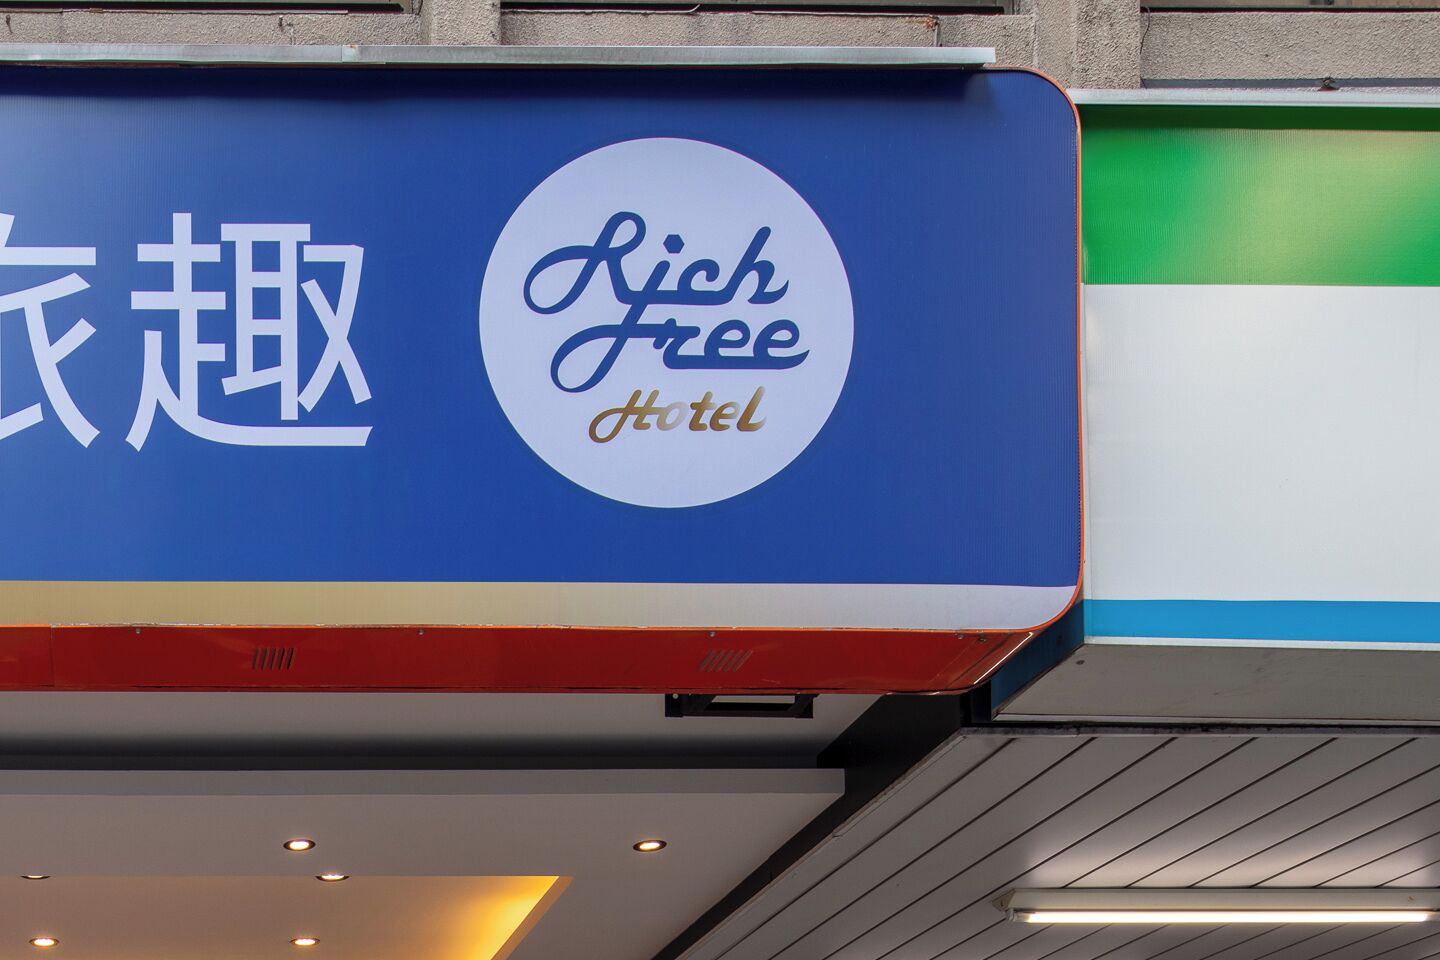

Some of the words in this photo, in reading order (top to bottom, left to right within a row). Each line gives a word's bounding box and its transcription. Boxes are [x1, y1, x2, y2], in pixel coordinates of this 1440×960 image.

[523, 211, 789, 315] Rich
[550, 303, 810, 393] Free
[588, 386, 767, 443] Hotel
